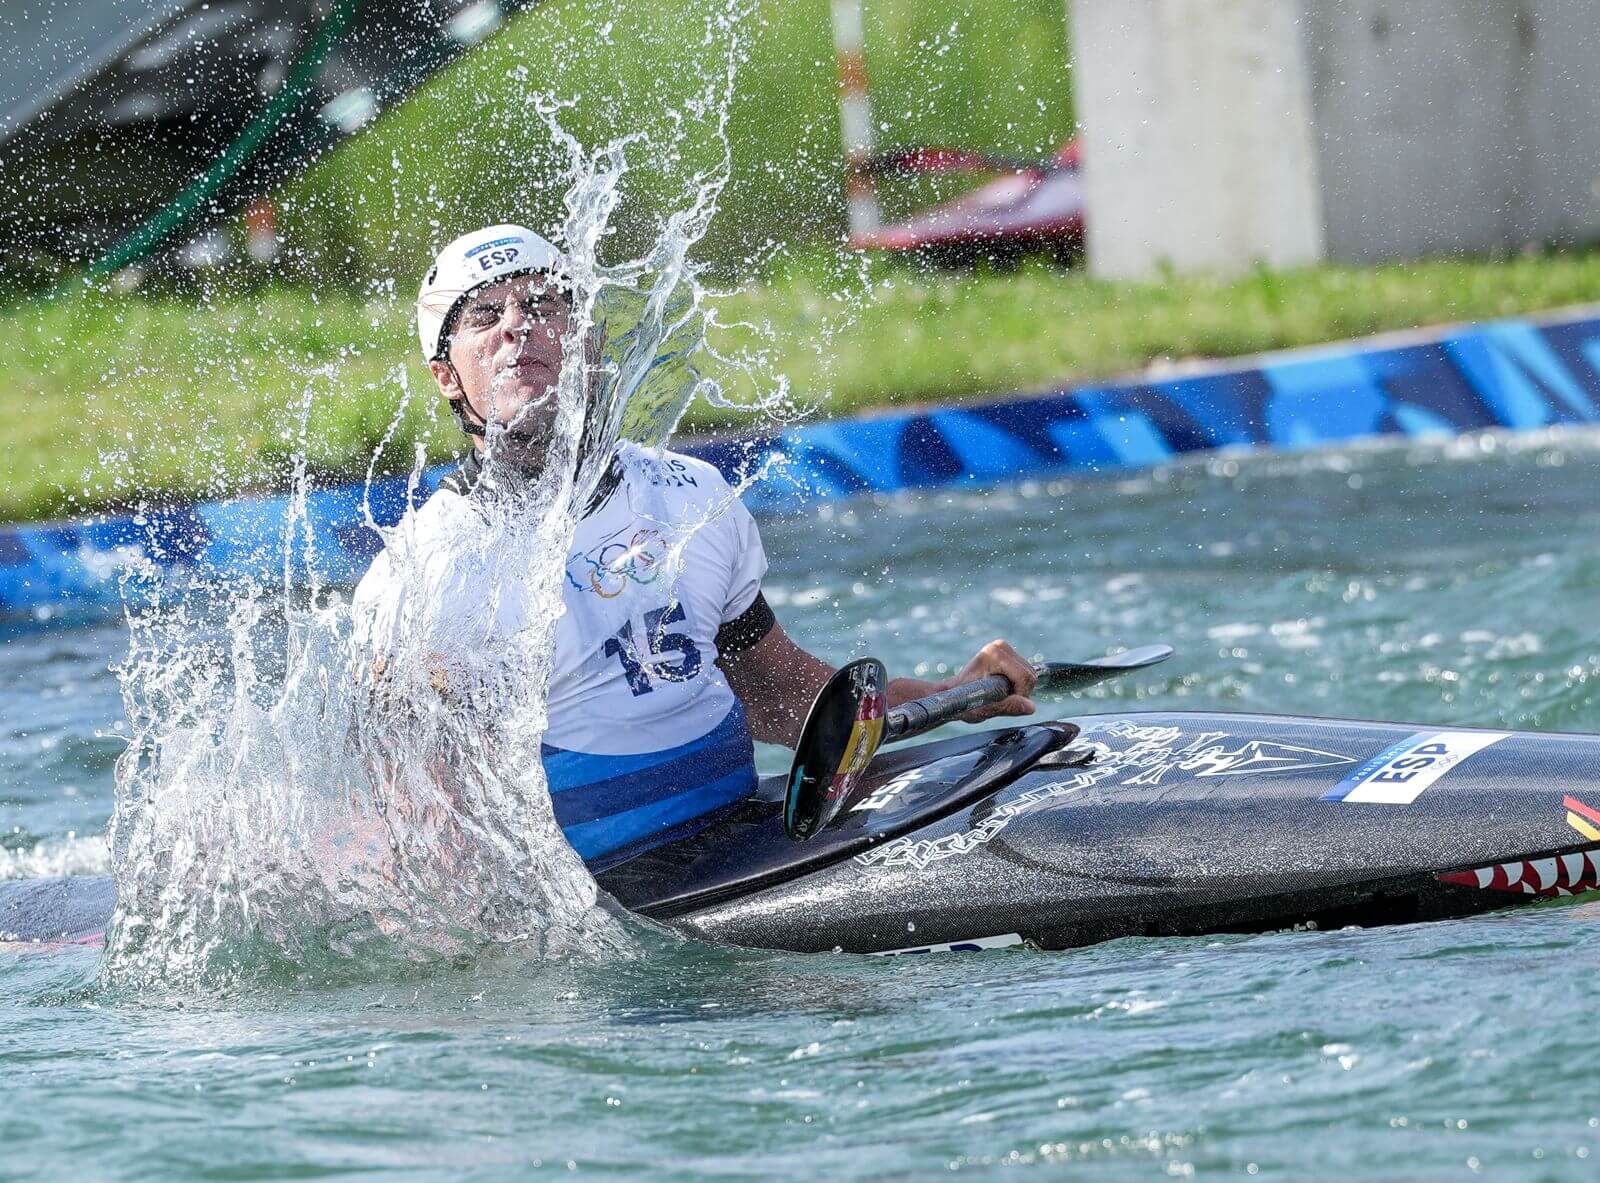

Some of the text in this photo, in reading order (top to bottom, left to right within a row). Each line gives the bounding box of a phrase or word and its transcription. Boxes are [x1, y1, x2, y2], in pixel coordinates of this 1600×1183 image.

[479, 248, 519, 270] ESP
[604, 602, 702, 697] 15
[1370, 743, 1450, 783] ESP
